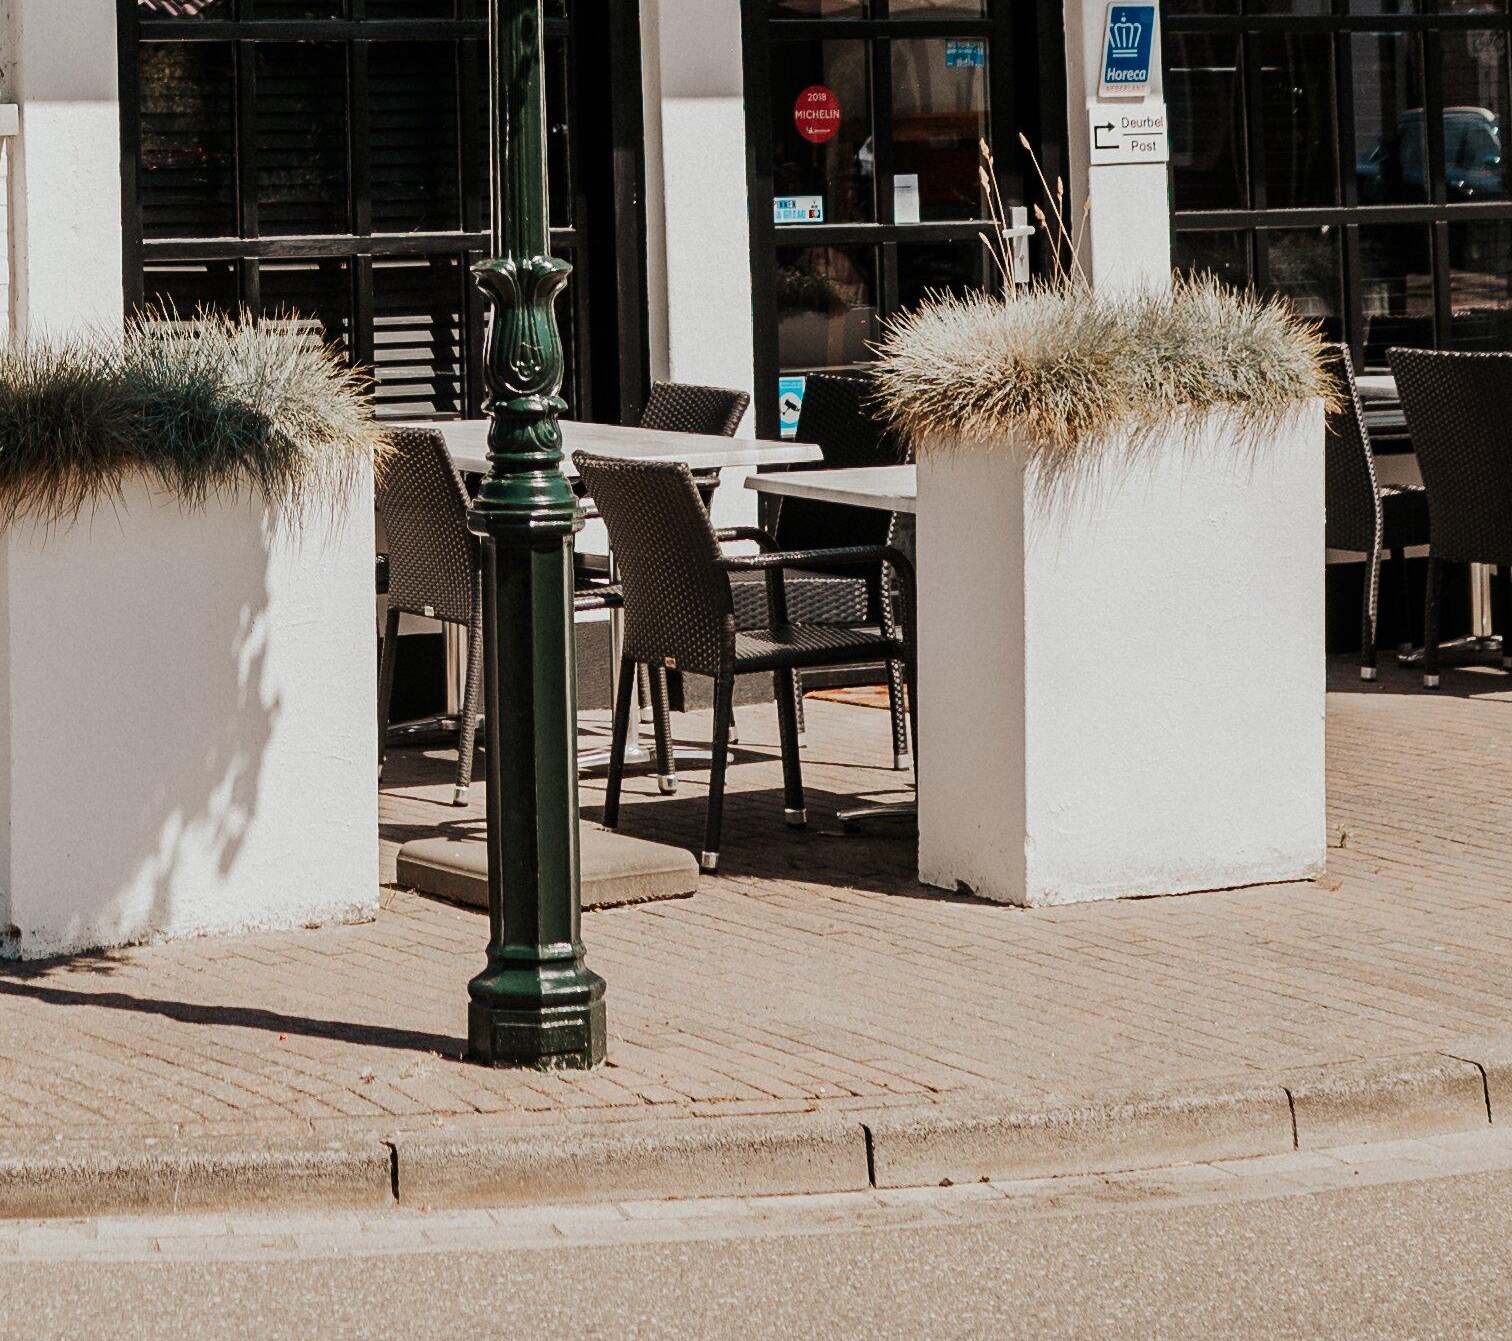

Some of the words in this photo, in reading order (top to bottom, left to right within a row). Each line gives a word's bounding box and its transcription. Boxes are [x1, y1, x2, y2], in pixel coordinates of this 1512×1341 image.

[1107, 68, 1147, 81] Horeca
[795, 110, 840, 119] MICHELIN
[1121, 117, 1163, 128] Deurbel
[1131, 141, 1156, 151] Post
